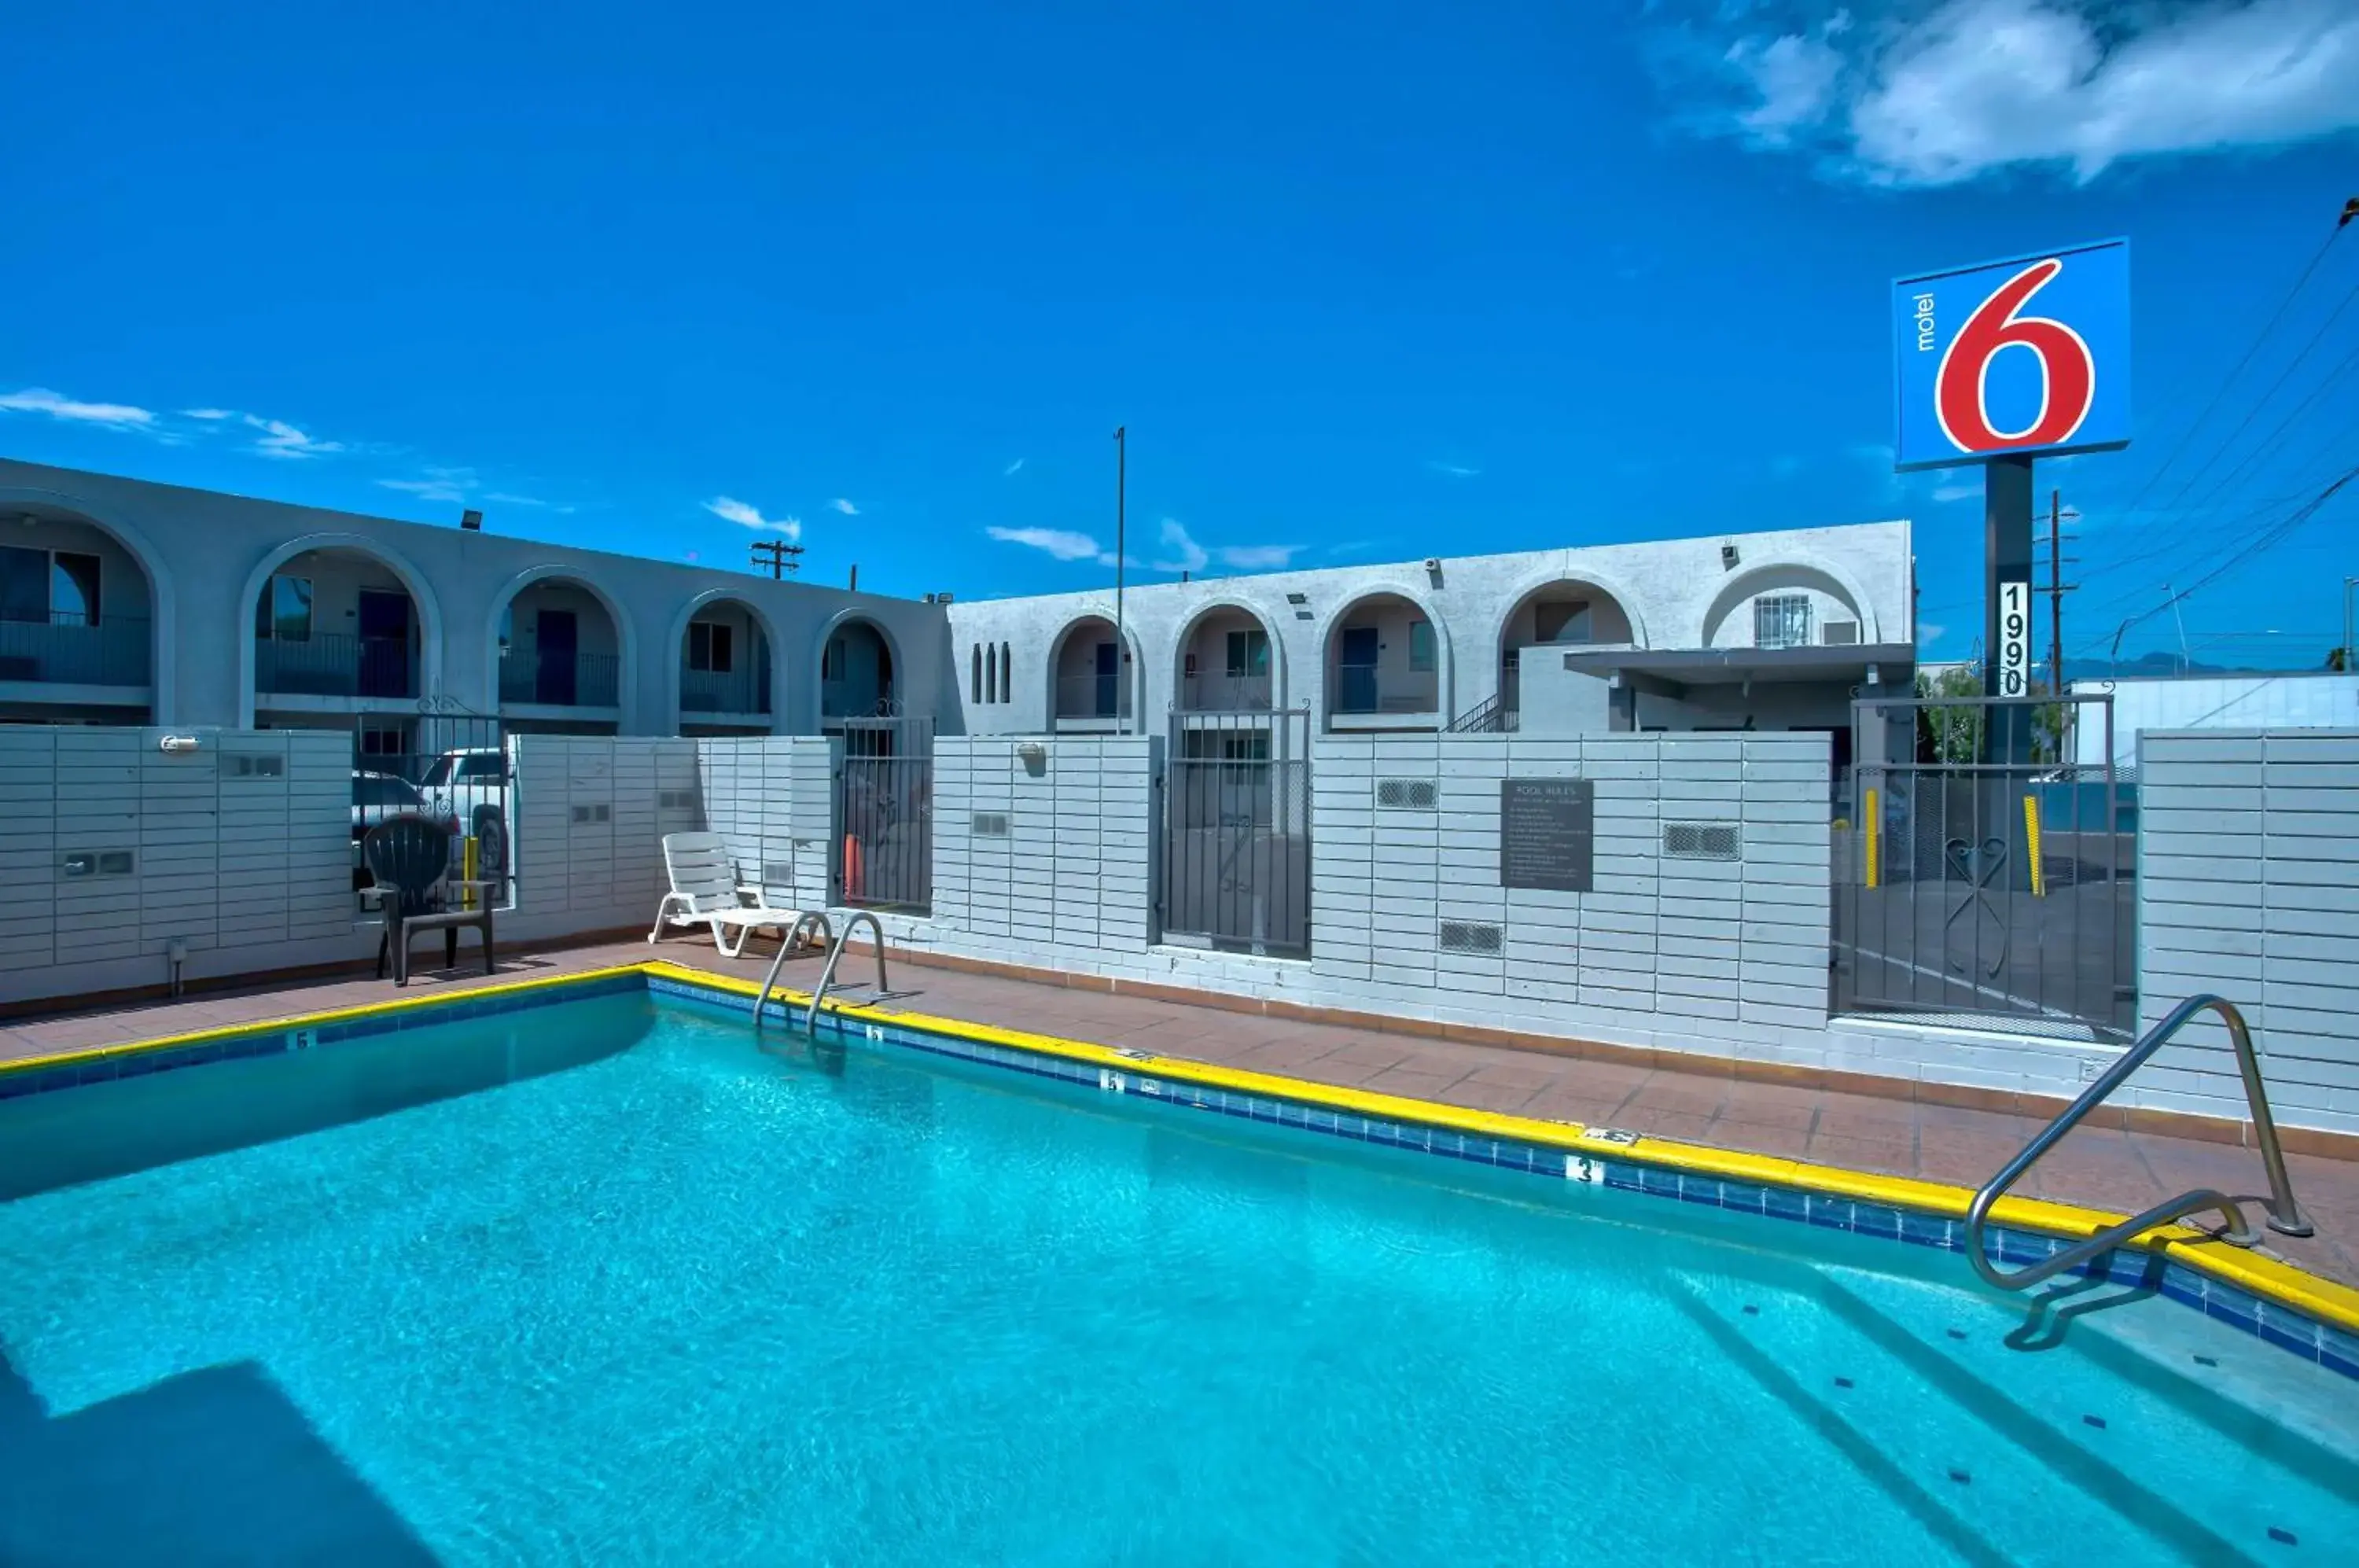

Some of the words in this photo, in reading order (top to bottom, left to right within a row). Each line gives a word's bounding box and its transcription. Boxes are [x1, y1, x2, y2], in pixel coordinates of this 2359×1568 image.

[1912, 292, 1935, 352] motel
[1934, 257, 2096, 454] 6
[2006, 585, 2024, 694] 1990
[1515, 786, 1543, 796] POOL
[1577, 1156, 1592, 1182] 3
